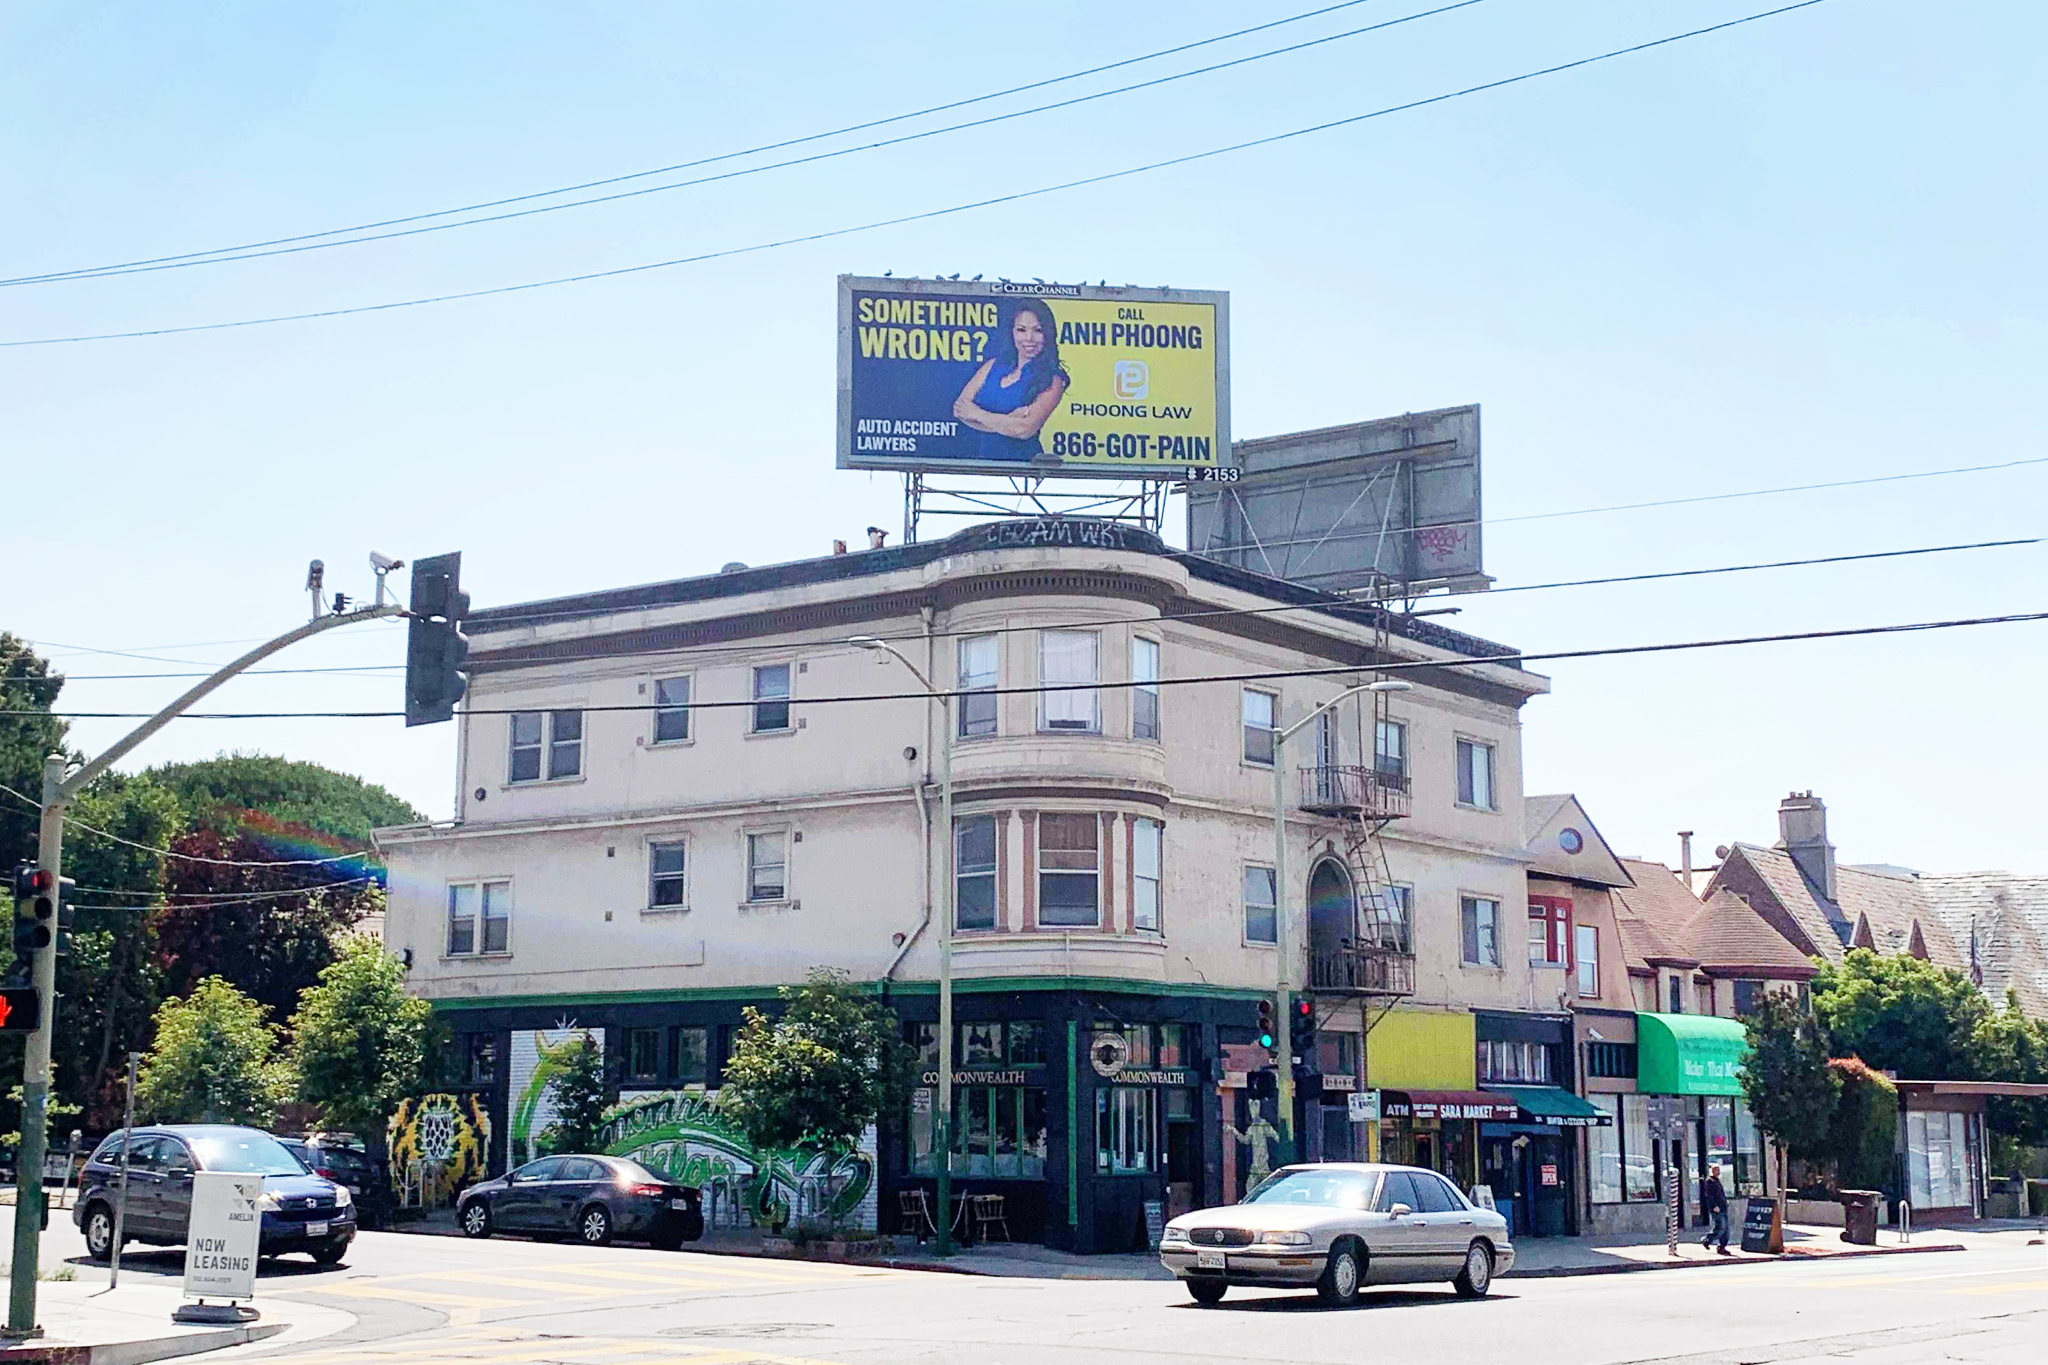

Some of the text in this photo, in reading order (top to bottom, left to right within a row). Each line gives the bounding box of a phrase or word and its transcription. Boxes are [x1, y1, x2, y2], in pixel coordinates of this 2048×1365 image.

[857, 297, 998, 328] SOMETHING
[1117, 308, 1145, 321] CALL
[1059, 321, 1203, 350] ANH PHOONG
[858, 326, 989, 363] WRONG?
[1070, 403, 1193, 420] PHOONG LAW
[857, 418, 958, 437] AUTO ACCIDENT
[857, 435, 916, 452] LAWYERS
[1052, 431, 1211, 461] 866-GOT-PAIN
[1203, 468, 1239, 482] 2153
[923, 1071, 1025, 1084] COMONWEALTH
[1386, 1104, 1409, 1116] ATM
[1440, 1104, 1461, 1119] SARA
[1463, 1104, 1494, 1119] MARKET
[196, 1238, 226, 1252] NOW
[194, 1255, 250, 1271] LEASING
